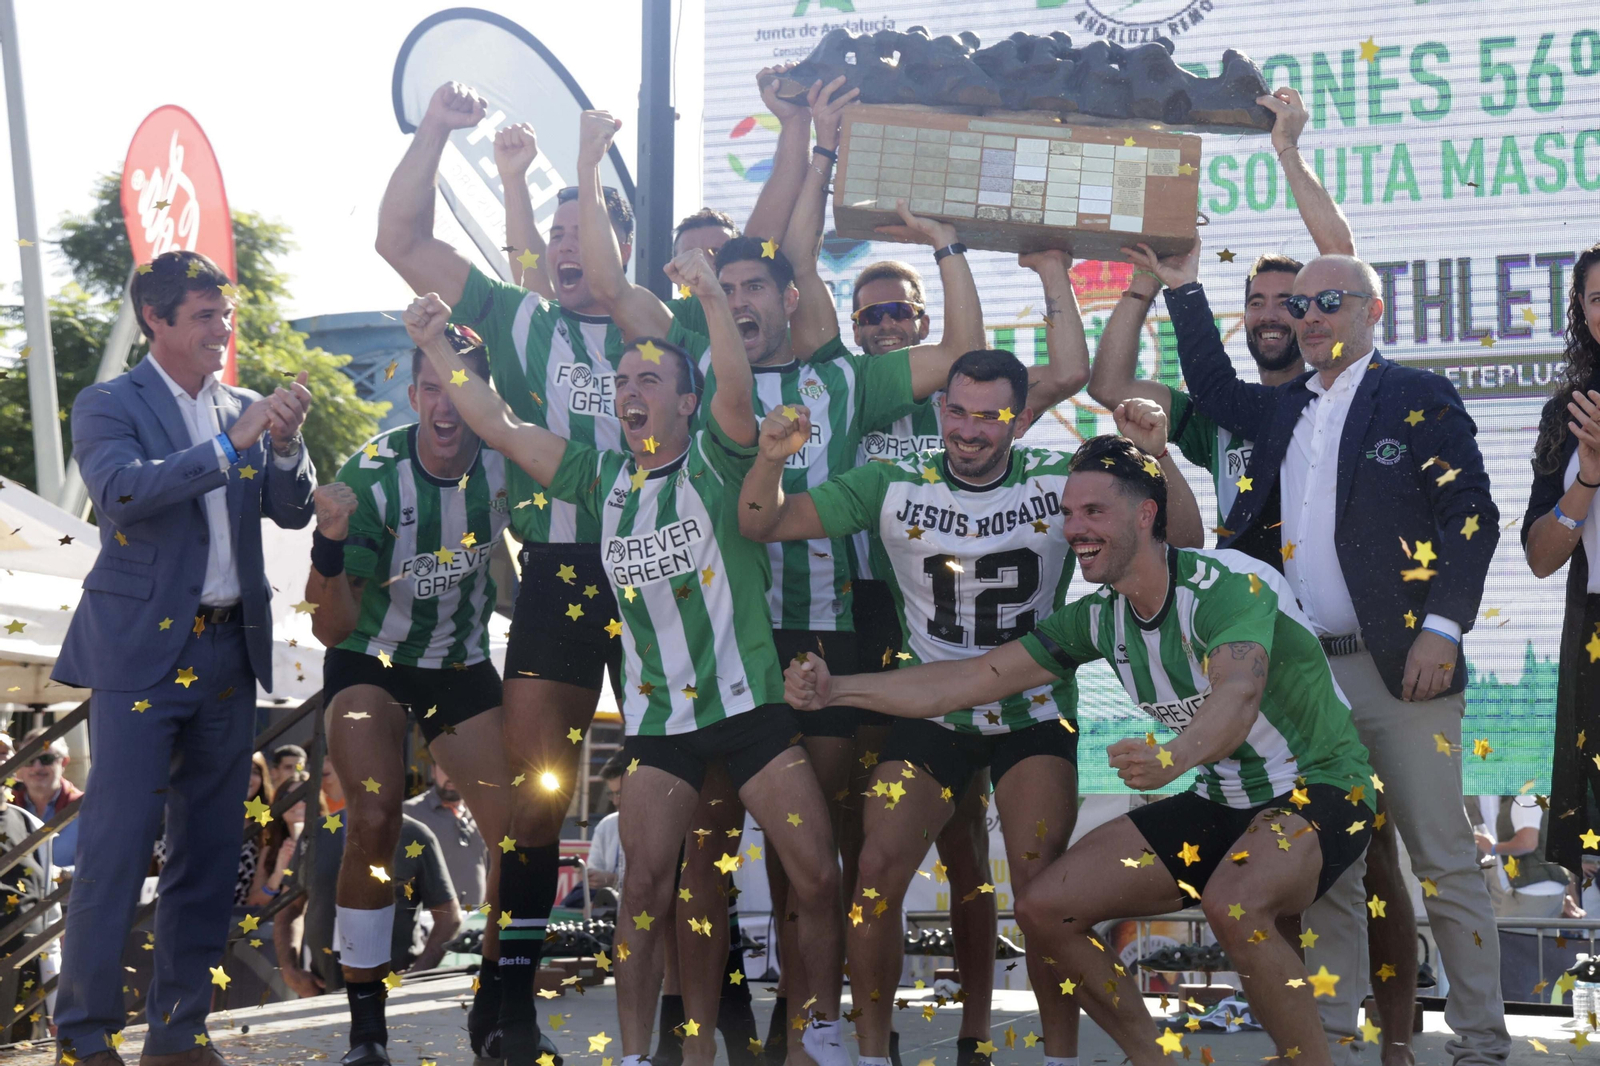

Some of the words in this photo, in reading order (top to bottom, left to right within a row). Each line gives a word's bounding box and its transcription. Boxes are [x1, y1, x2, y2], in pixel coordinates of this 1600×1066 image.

[755, 24, 795, 41] Junta
[799, 23, 817, 37] de
[1167, 0, 1213, 35] REMO
[896, 499, 969, 537] JESÚS
[975, 491, 1061, 538] ROSADO
[613, 549, 692, 586] GREEN
[923, 547, 1043, 649] 12
